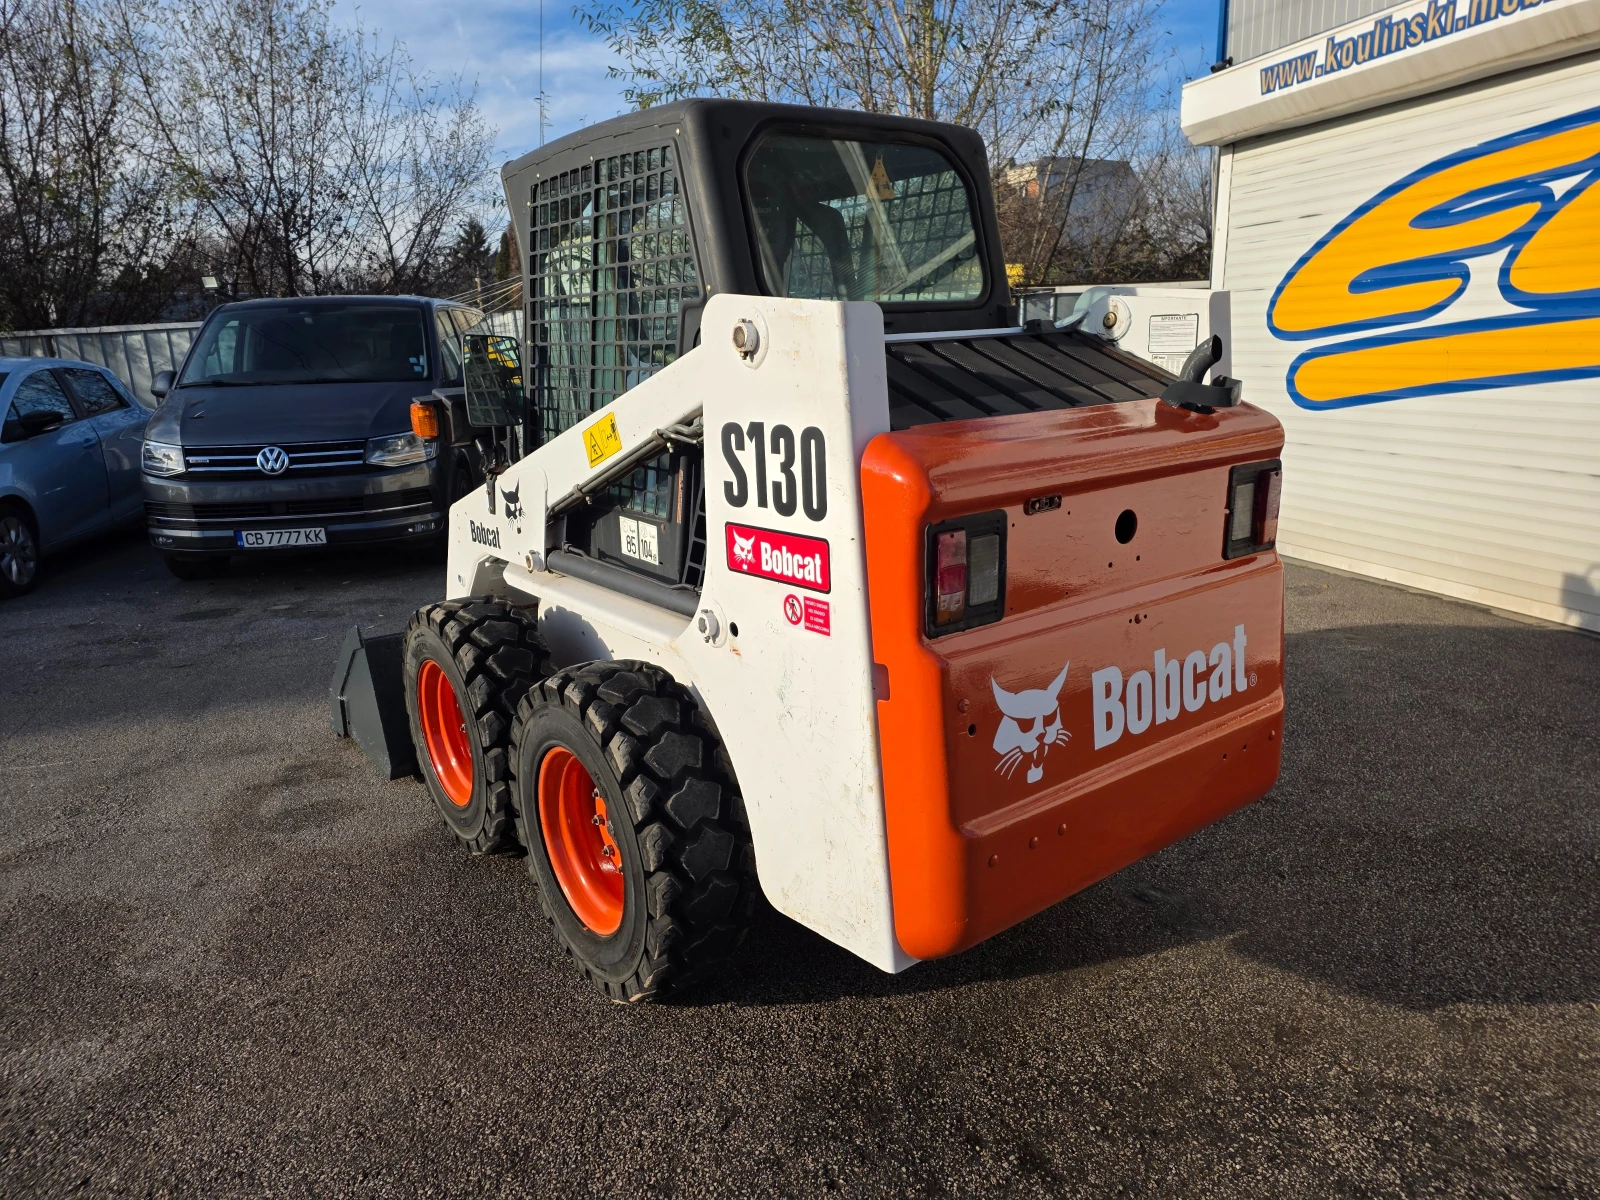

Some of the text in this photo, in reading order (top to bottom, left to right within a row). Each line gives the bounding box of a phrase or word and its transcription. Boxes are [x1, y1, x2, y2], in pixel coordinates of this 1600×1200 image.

[1260, 0, 1556, 95] www.koulinski.m
[721, 421, 828, 522] S130
[245, 532, 264, 546] CB
[266, 530, 302, 545] 7777
[304, 529, 323, 543] KK
[470, 519, 501, 549] Bobcat
[625, 534, 637, 555] 85
[640, 538, 653, 561] 104
[760, 541, 822, 584] Bobcat
